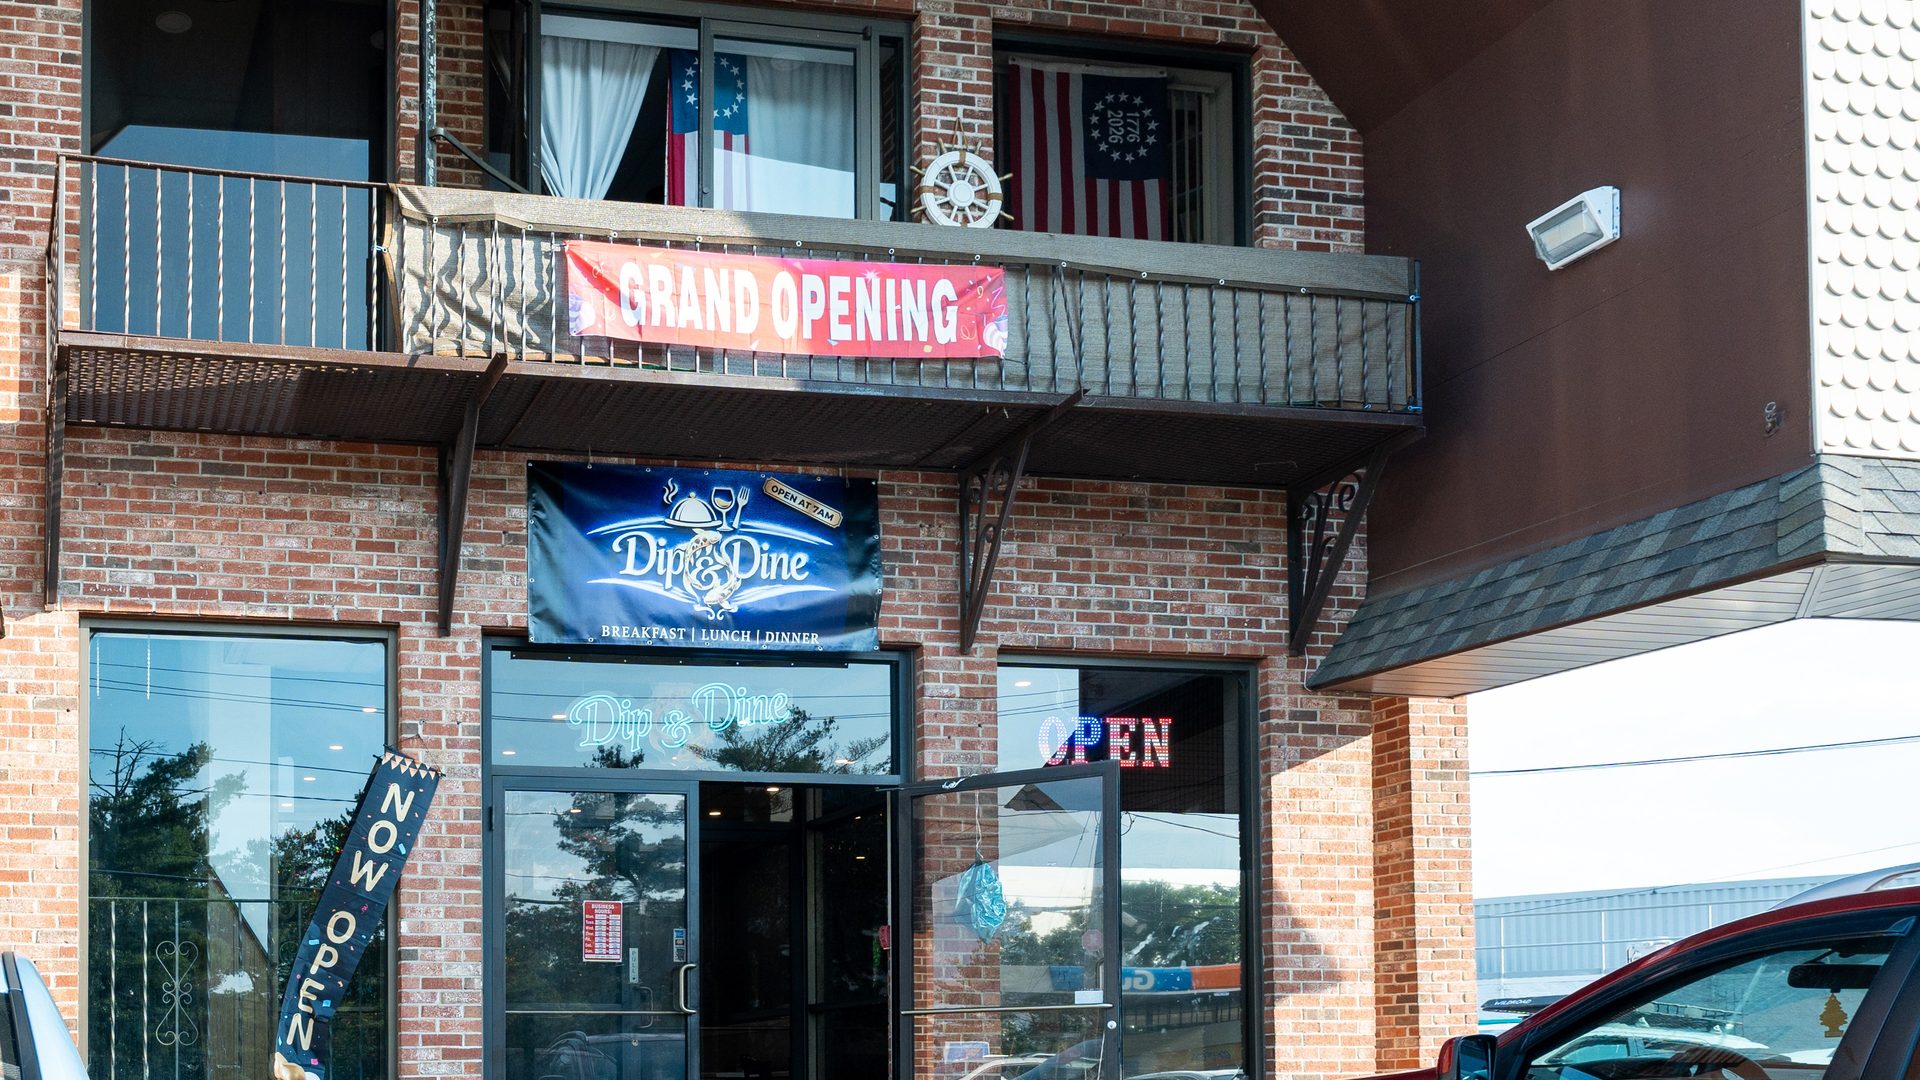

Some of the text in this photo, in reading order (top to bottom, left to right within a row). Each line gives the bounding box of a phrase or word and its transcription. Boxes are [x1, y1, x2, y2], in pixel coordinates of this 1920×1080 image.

[1107, 110, 1124, 144] 2026
[1126, 112, 1140, 142] 1776
[619, 262, 958, 344] GRAND OPENING
[771, 485, 834, 521] OPEN AT 7AM
[612, 531, 810, 591] Dip & Dine
[601, 625, 820, 645] BREAKFAST LUNCH DINNER
[569, 683, 791, 752] Dip & Dine
[1038, 716, 1172, 767] OPEN
[286, 783, 415, 1051] NOW OPEN
